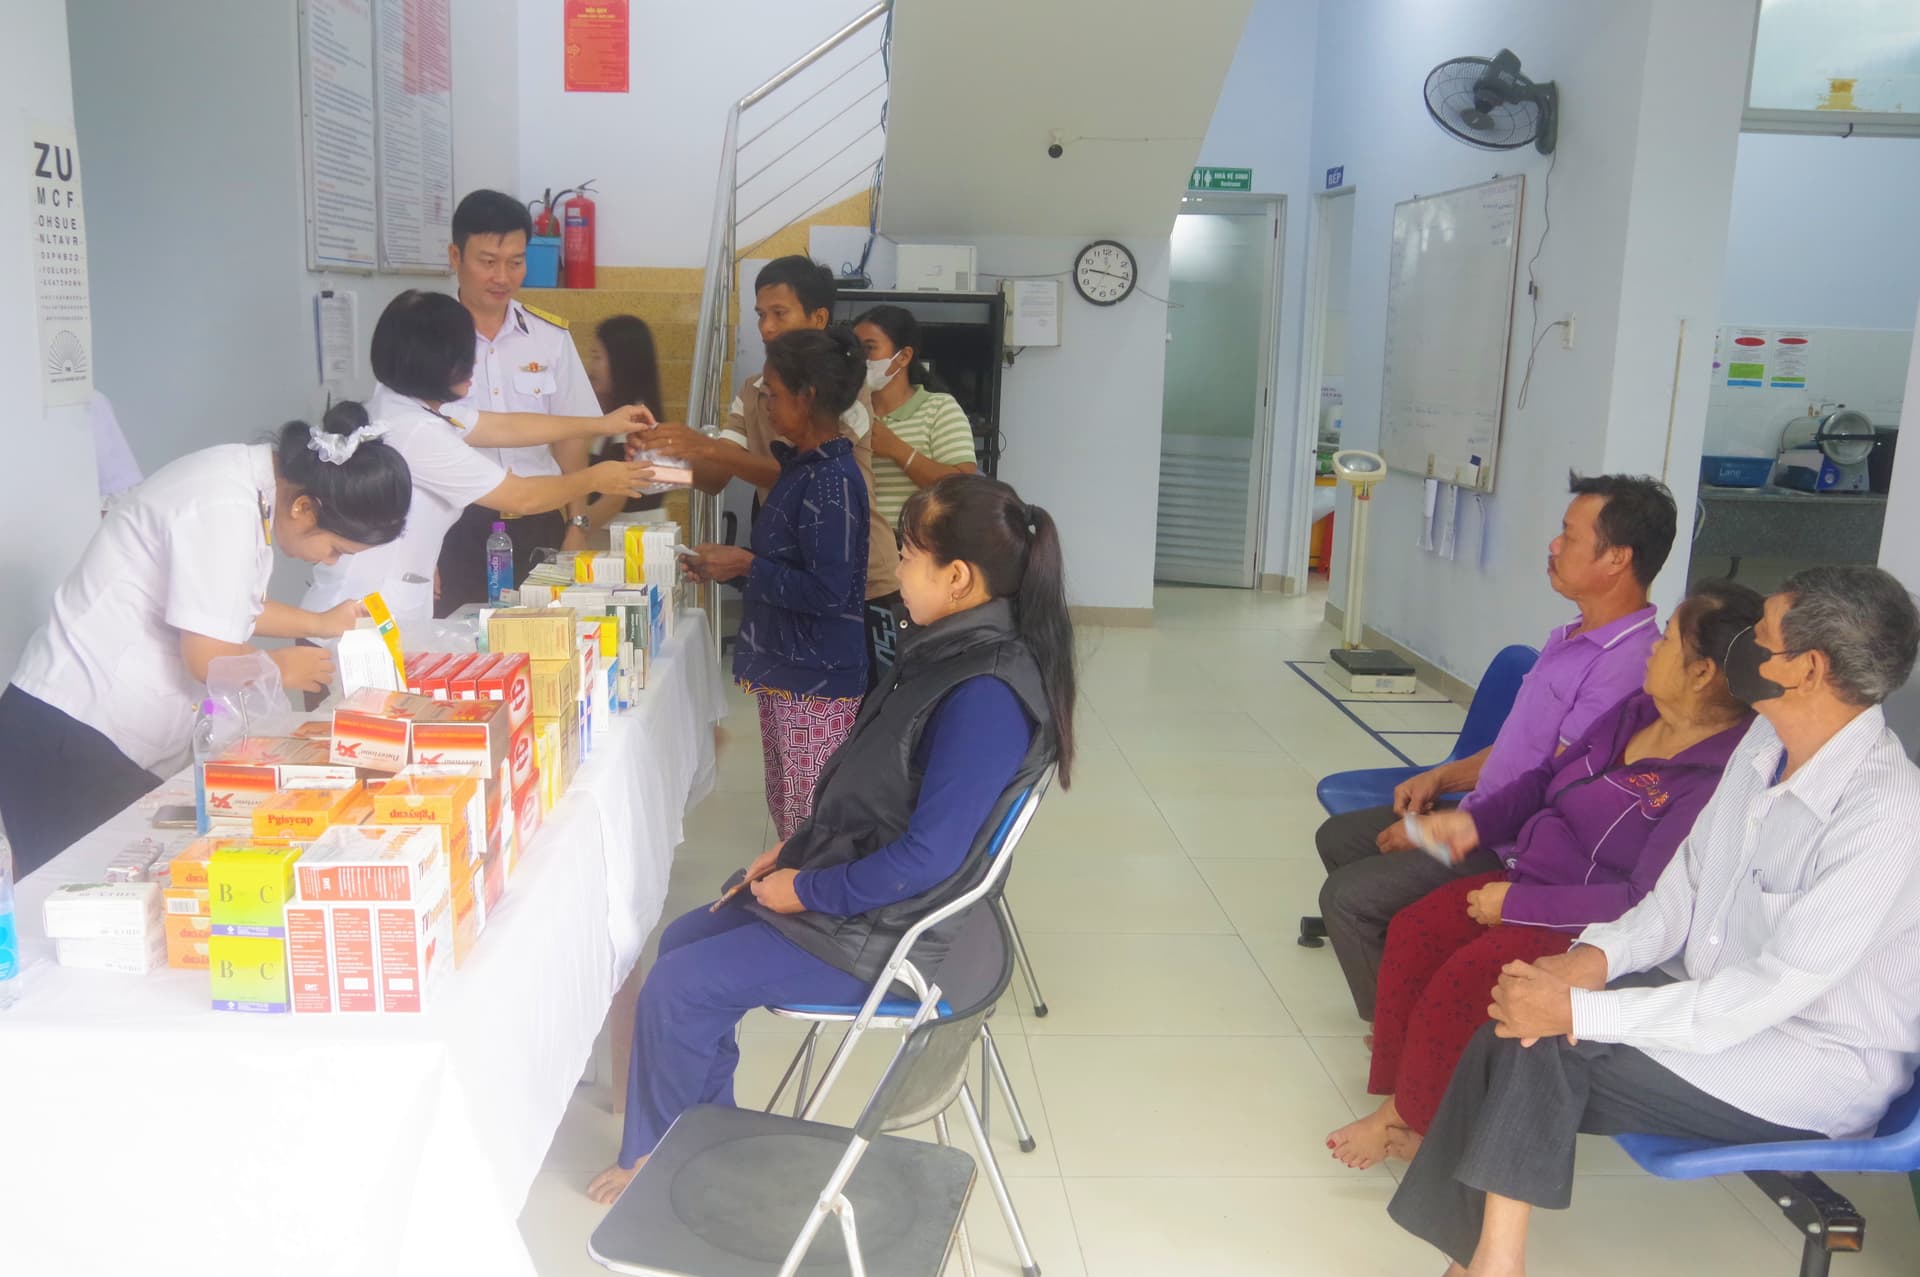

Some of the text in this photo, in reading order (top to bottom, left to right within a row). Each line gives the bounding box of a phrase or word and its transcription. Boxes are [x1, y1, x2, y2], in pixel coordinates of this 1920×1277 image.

[33, 141, 73, 182] ZU
[218, 883, 273, 904] B C
[220, 959, 274, 981] B C
